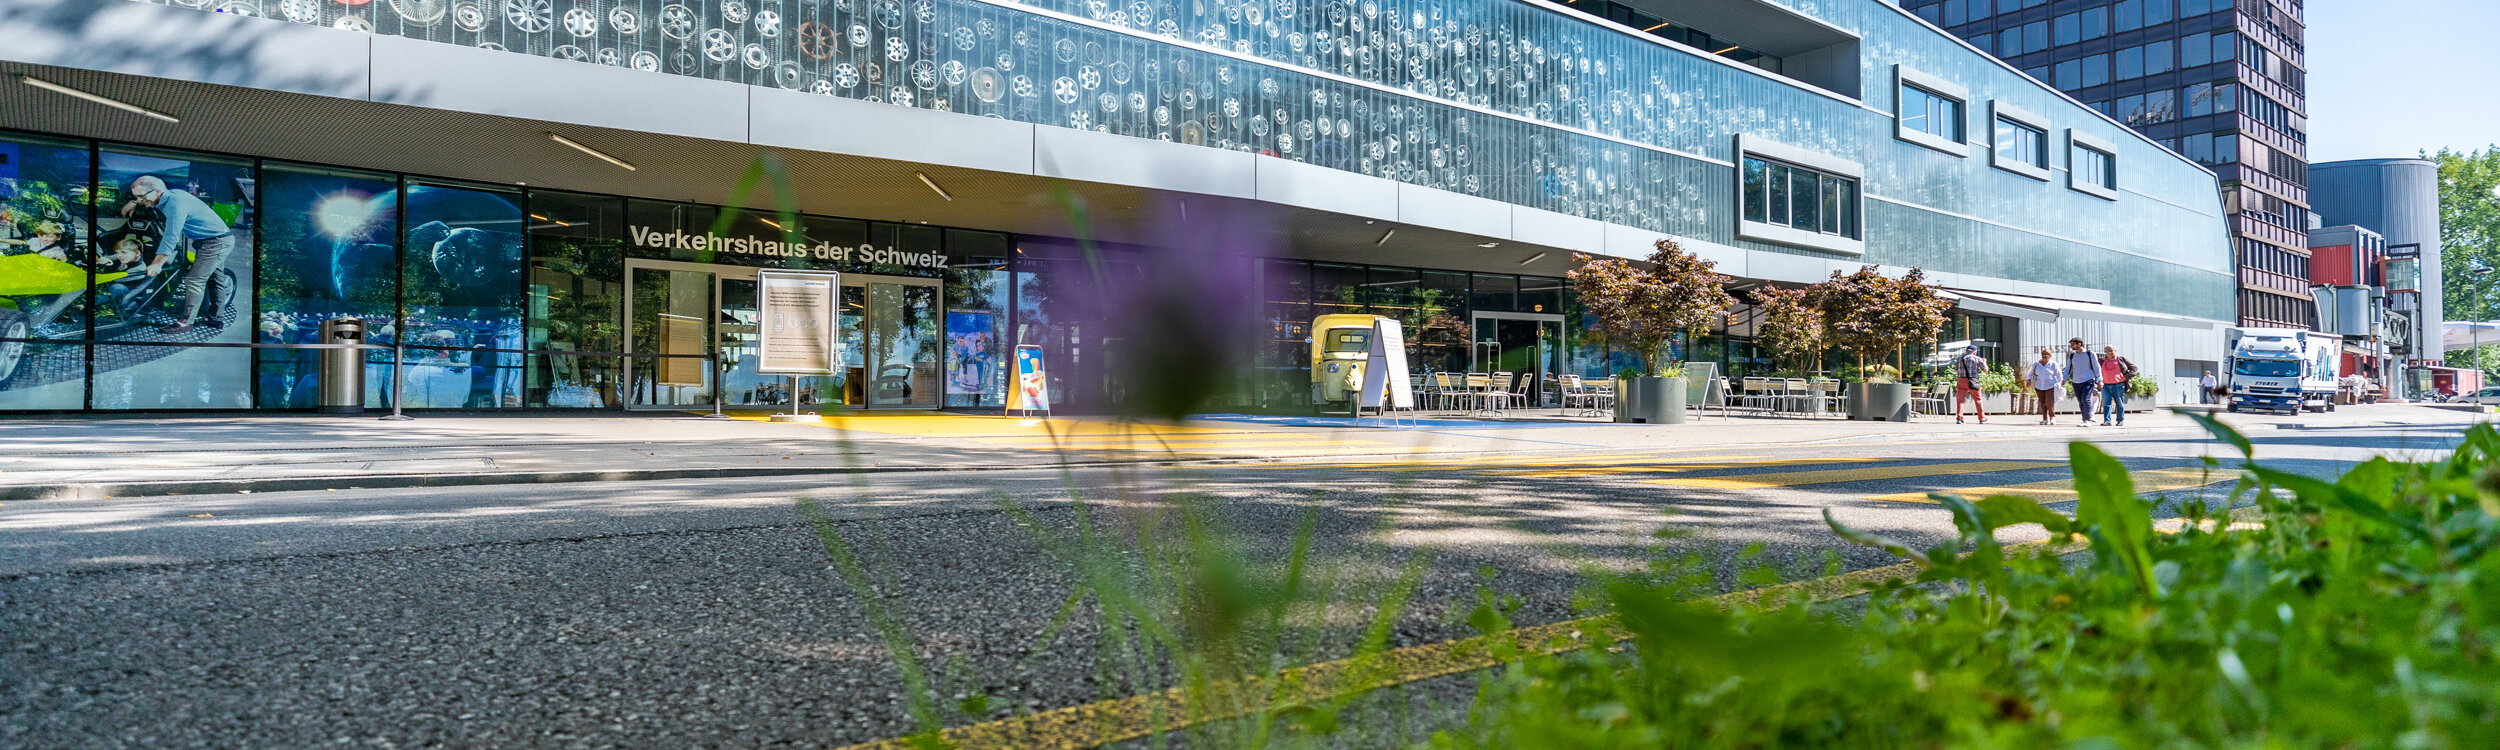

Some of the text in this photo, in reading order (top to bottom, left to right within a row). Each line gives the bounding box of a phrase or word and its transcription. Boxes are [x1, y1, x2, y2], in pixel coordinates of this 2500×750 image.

[629, 225, 948, 269] Verkehrshaus der Schweiz
